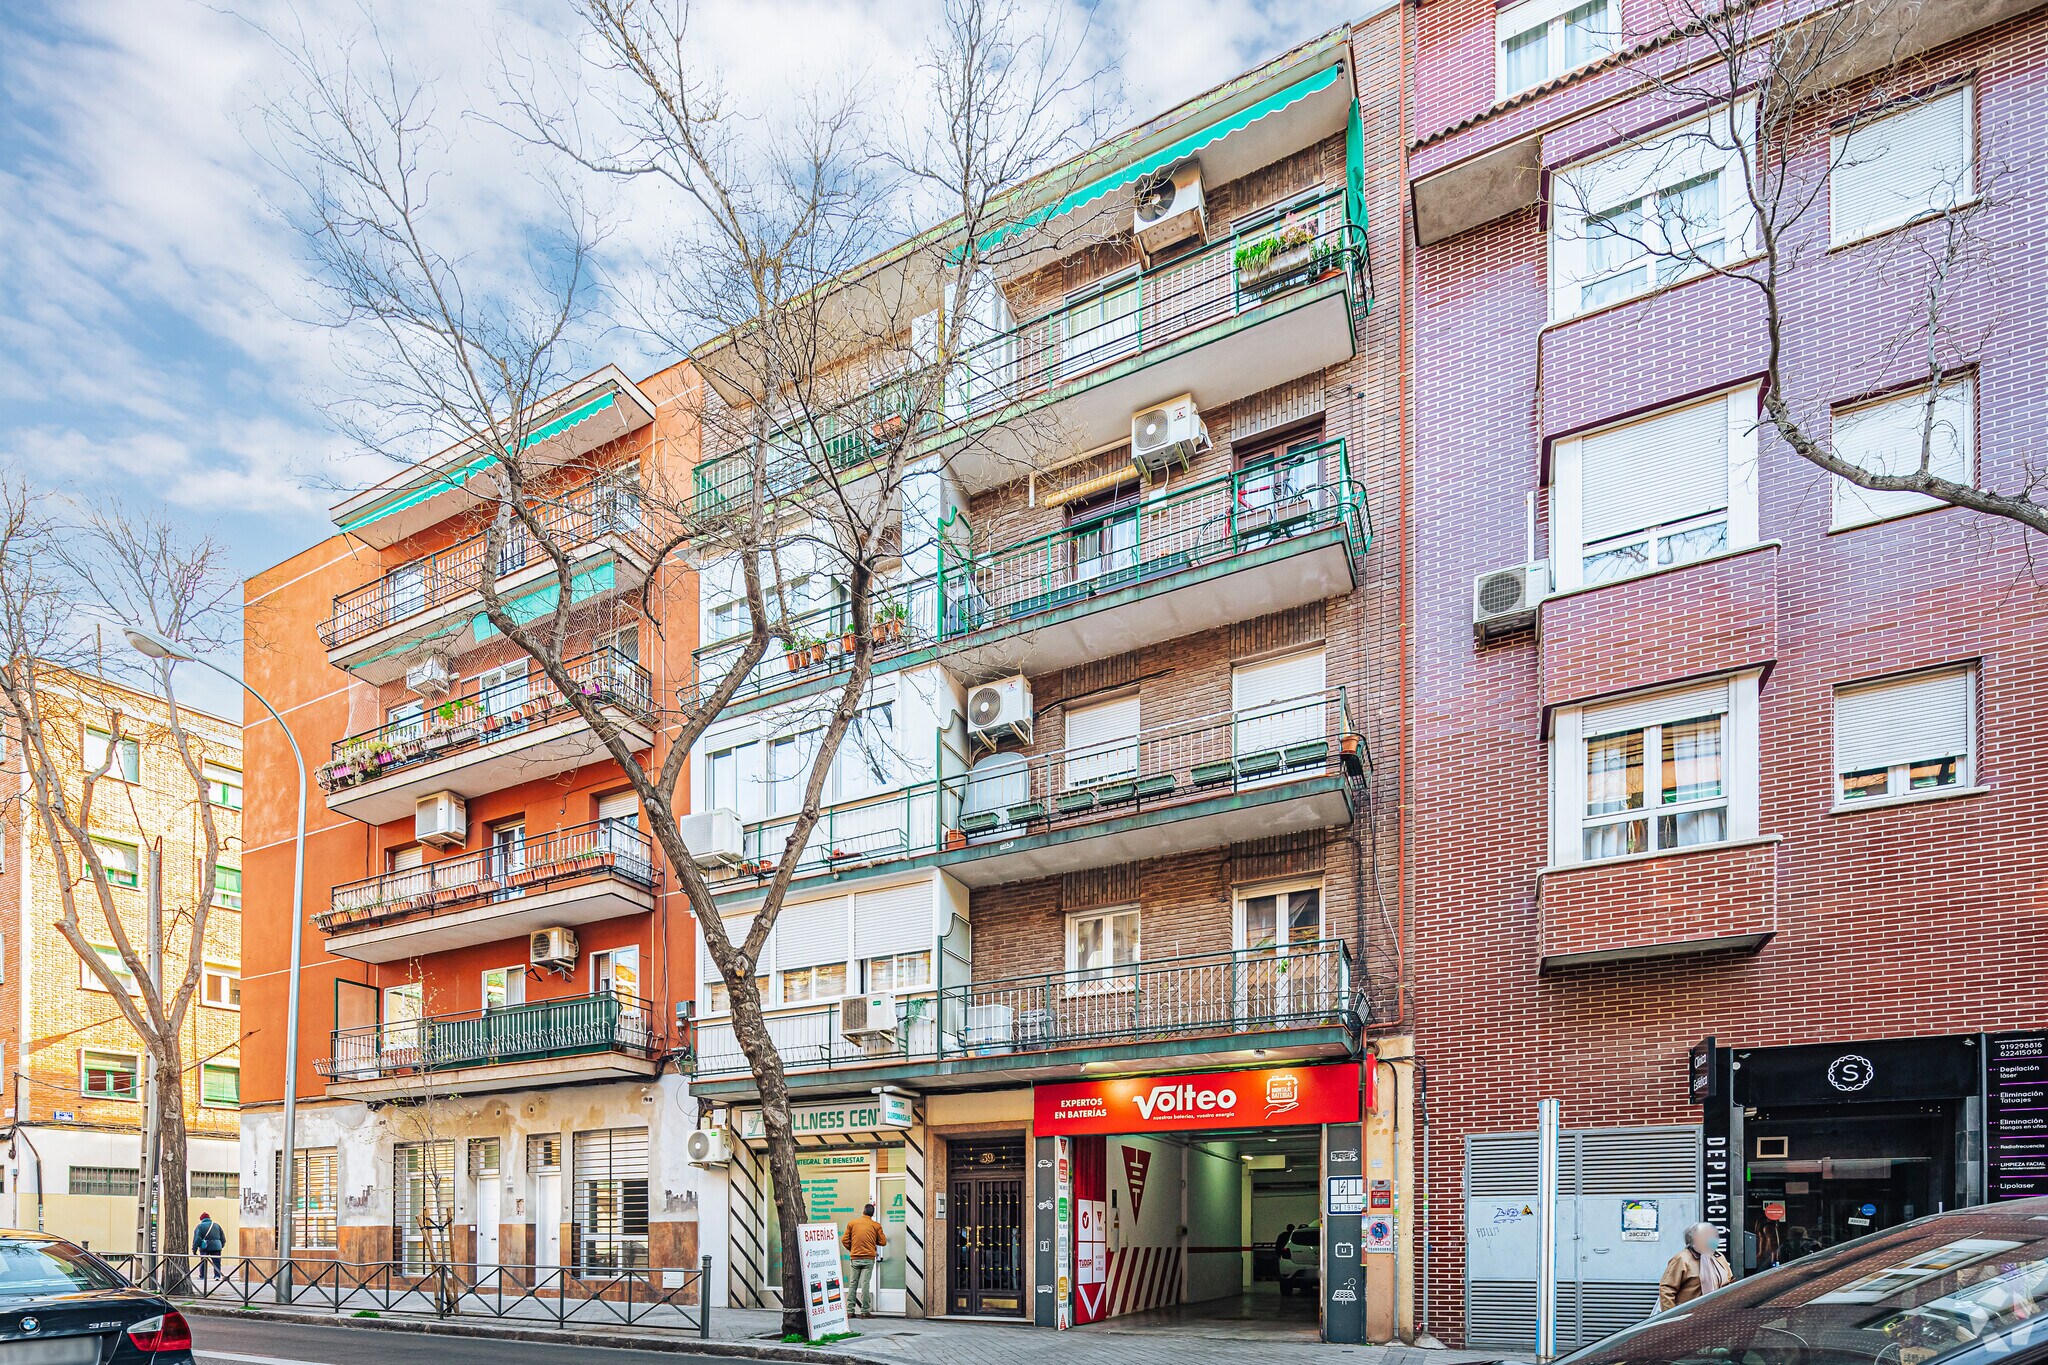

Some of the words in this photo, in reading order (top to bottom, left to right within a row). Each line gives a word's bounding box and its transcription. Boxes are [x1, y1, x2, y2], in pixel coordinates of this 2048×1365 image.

[2000, 1042, 2042, 1050] 919298816
[1842, 1064, 1859, 1082] S
[1060, 1097, 1103, 1108] EXPERTOS
[1132, 1084, 1237, 1120] Volteo
[1054, 1110, 1066, 1119] EN
[1067, 1108, 1107, 1118] BATERÍAS
[792, 1110, 844, 1130] LLNESS
[832, 1156, 864, 1164] BIENESTAR
[804, 1228, 834, 1242] BATERÍAS
